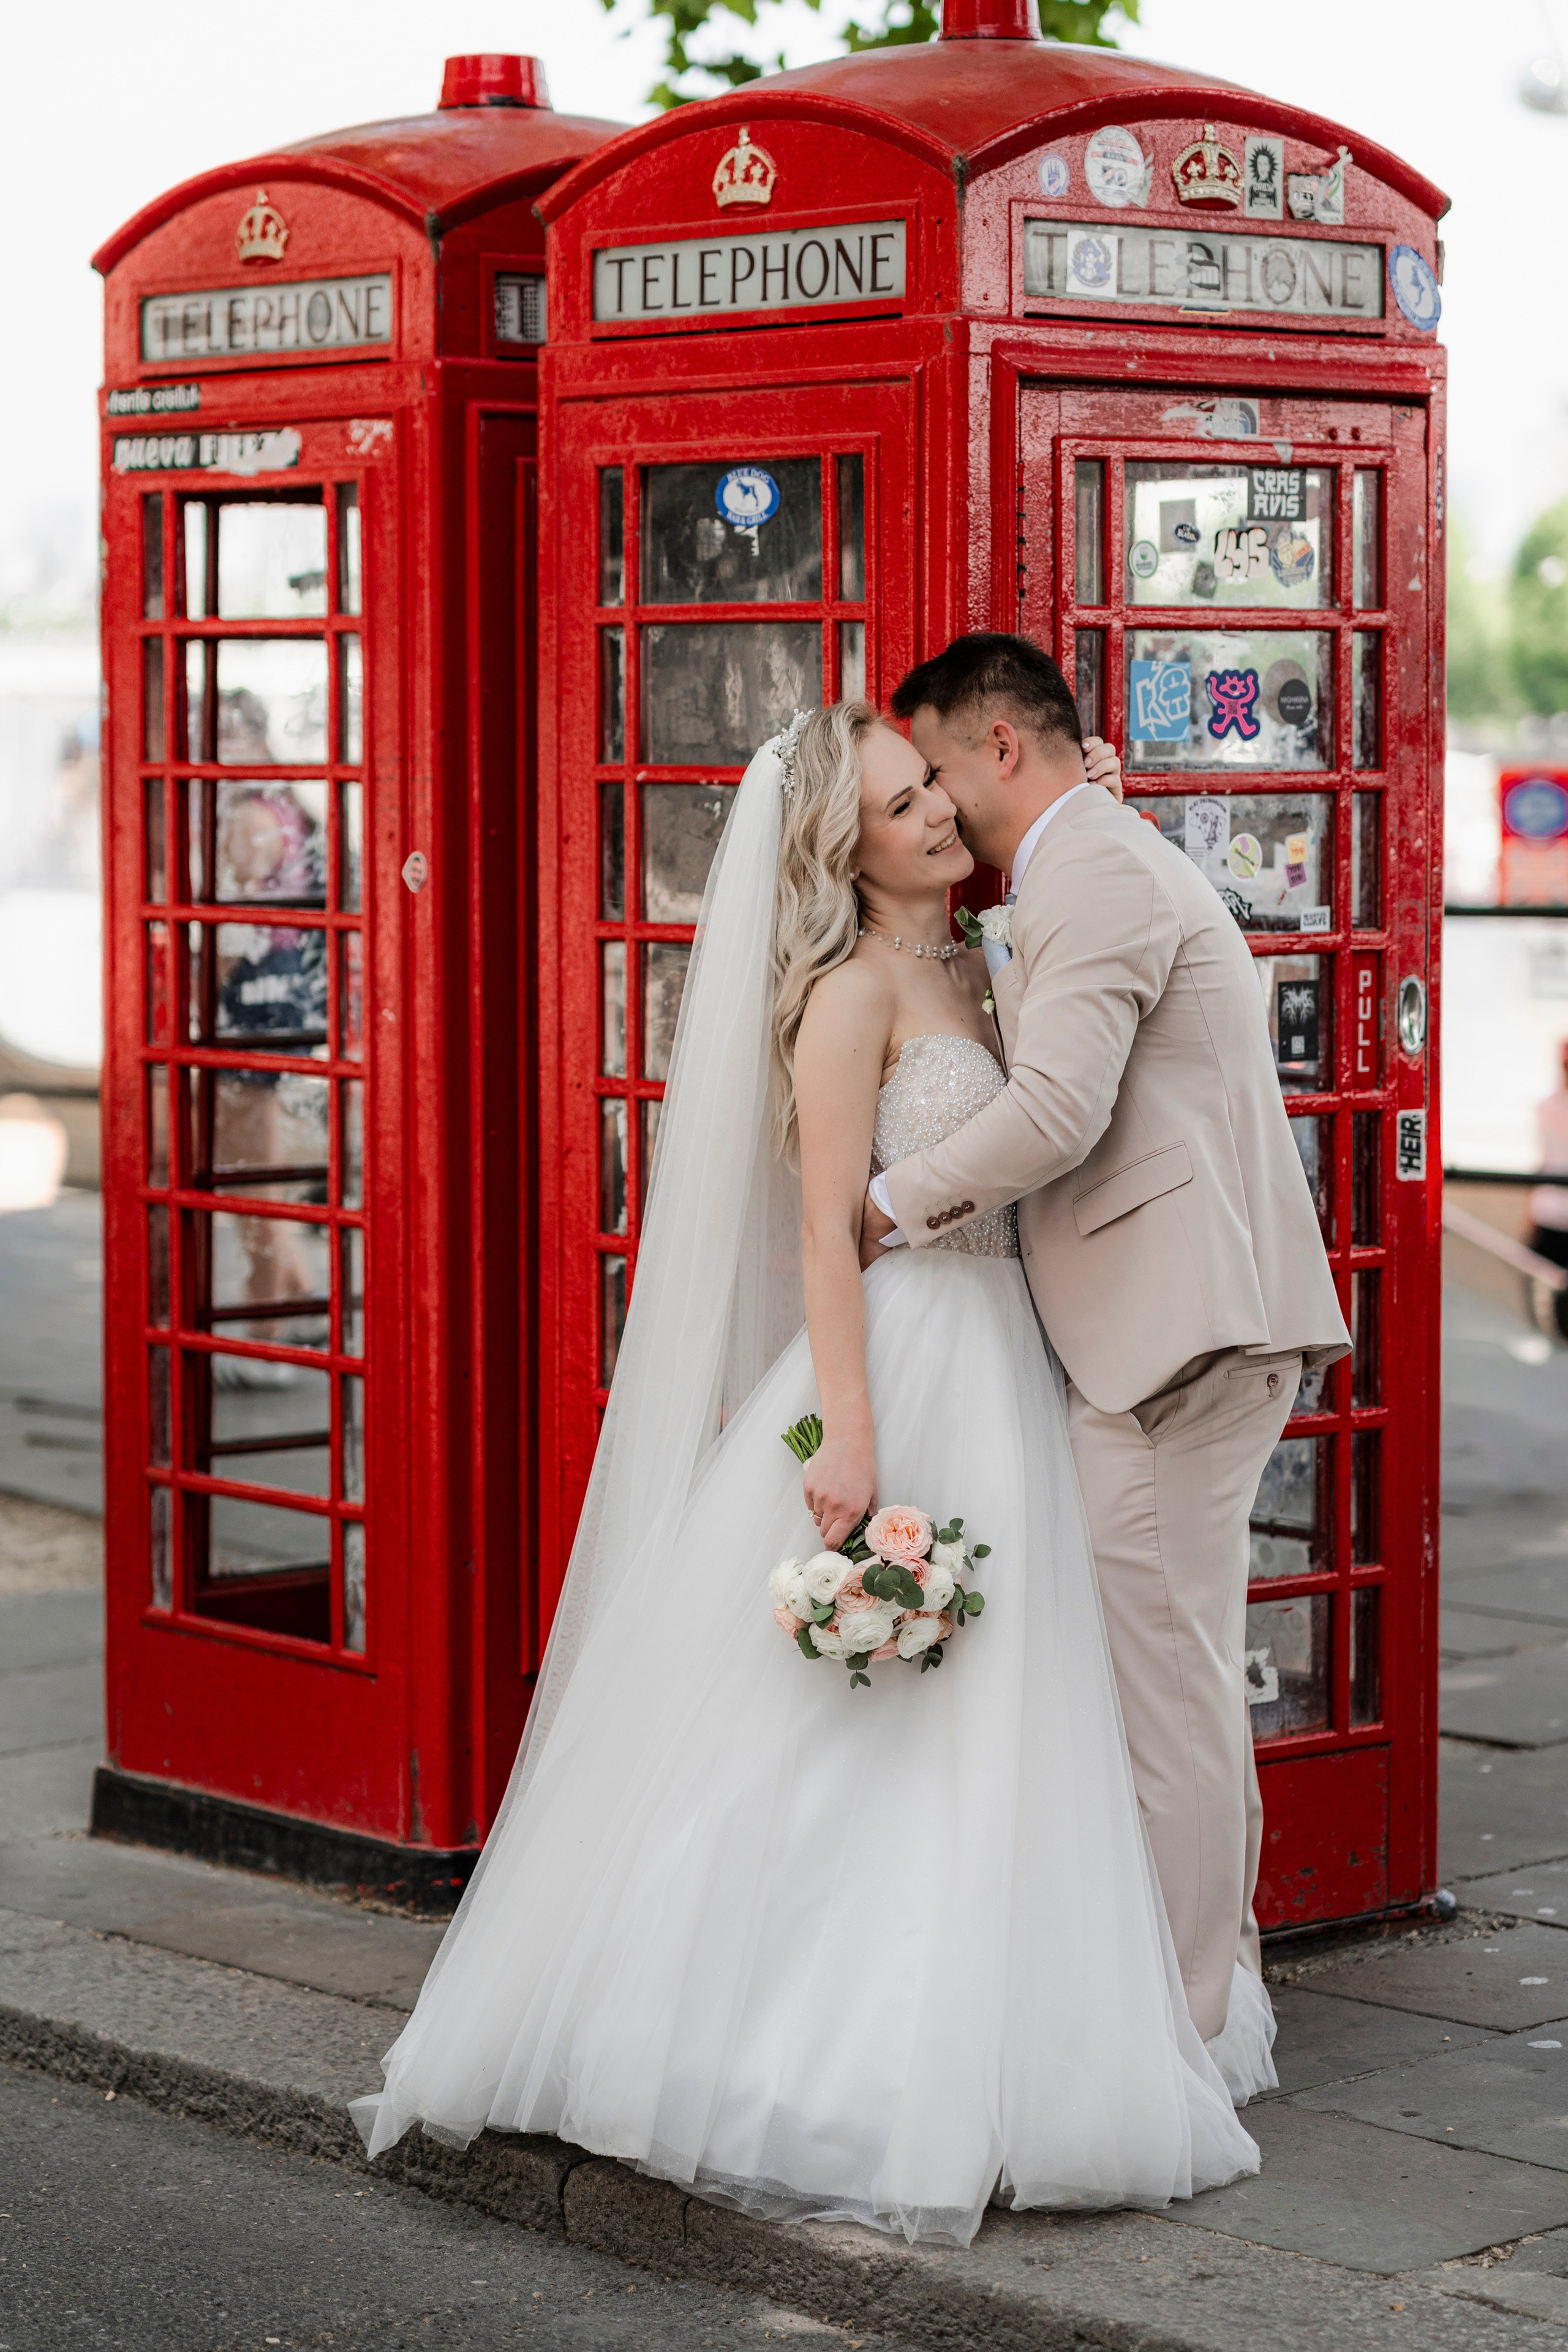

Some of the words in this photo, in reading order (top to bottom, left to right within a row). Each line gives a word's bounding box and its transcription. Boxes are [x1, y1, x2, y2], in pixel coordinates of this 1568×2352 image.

[605, 232, 895, 313] TELEPHONE
[1031, 230, 1365, 309] TLEPHONE
[153, 284, 385, 355] TELEPHONE
[727, 468, 748, 482] BLUE
[751, 469, 771, 483] DOG
[1253, 470, 1300, 494] CRAS
[1253, 492, 1300, 518] AVIS
[1357, 969, 1372, 1072] PULL
[1400, 1117, 1421, 1170] HEIR
